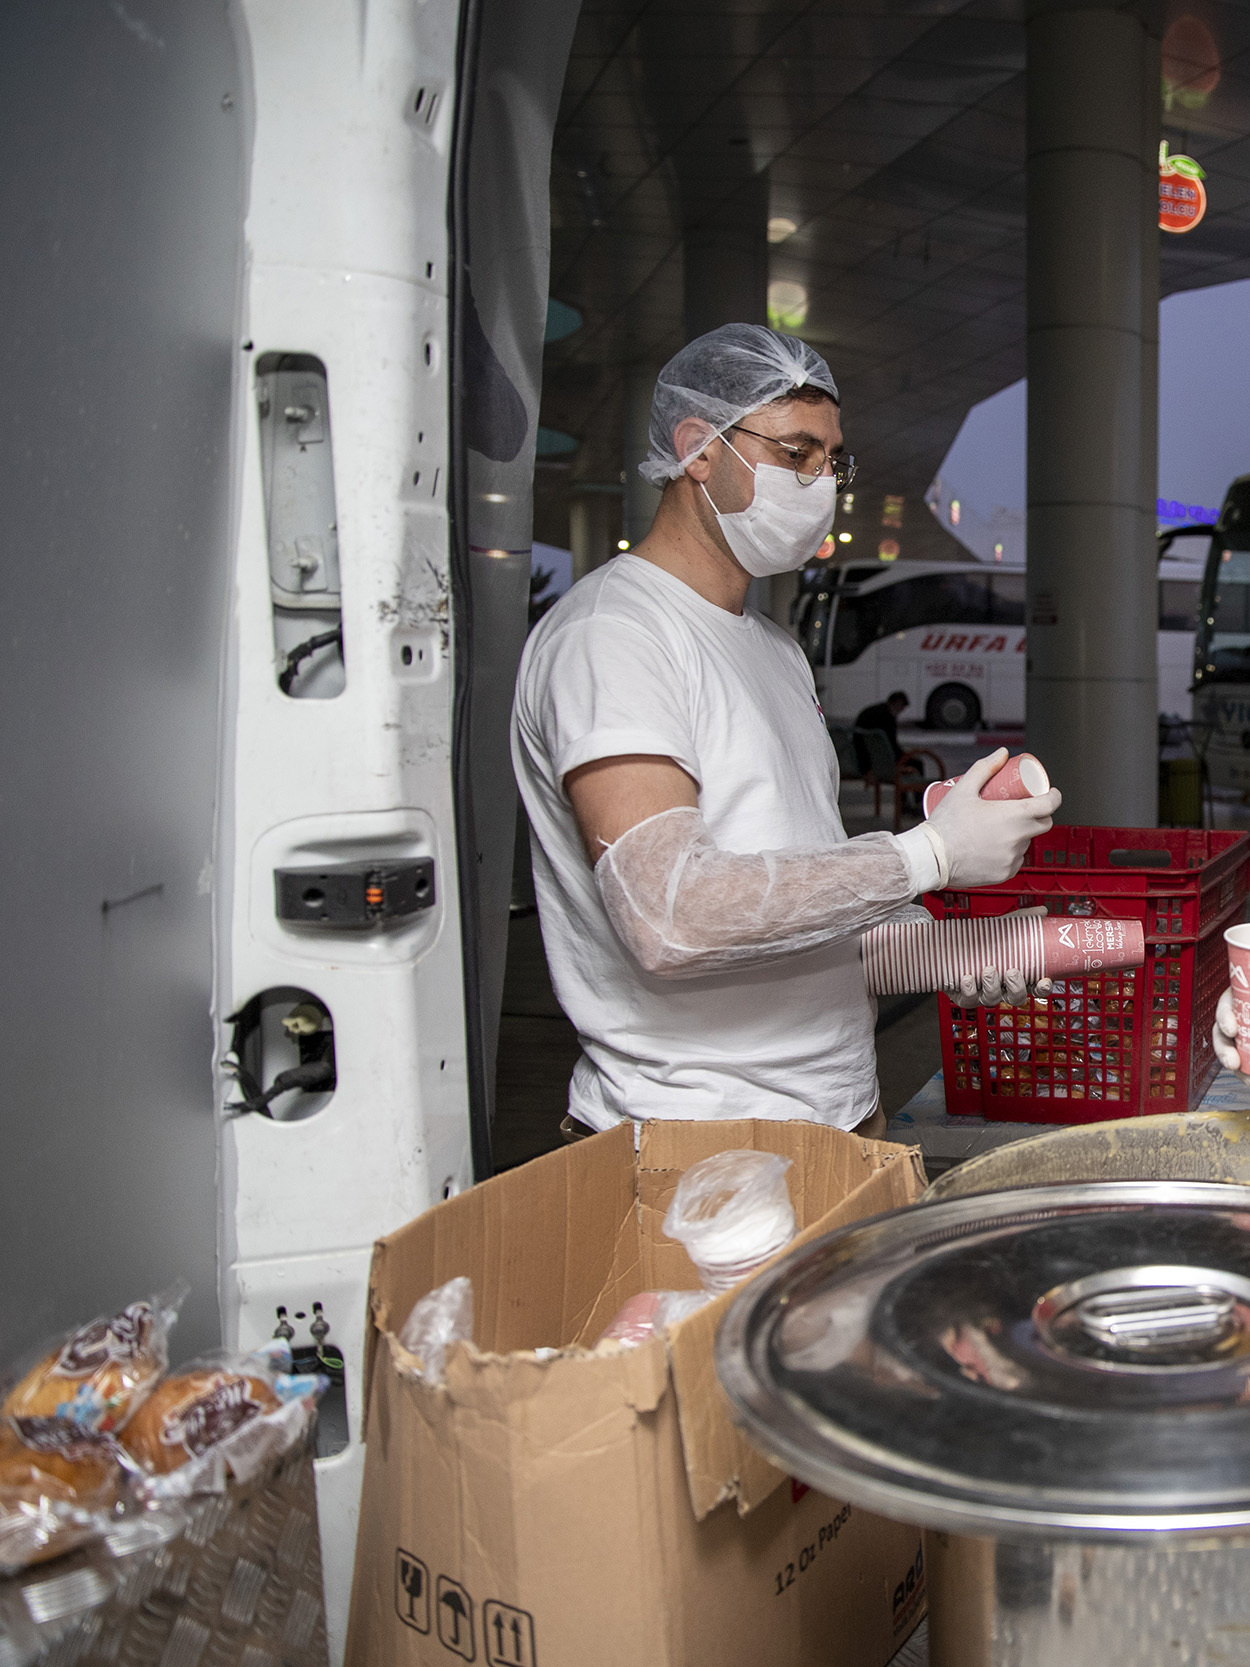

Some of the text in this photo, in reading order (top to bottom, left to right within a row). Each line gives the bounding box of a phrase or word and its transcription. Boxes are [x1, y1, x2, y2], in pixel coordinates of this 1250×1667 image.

[1159, 183, 1197, 202] ELEN
[775, 1501, 852, 1596] 12 Oz Paper
